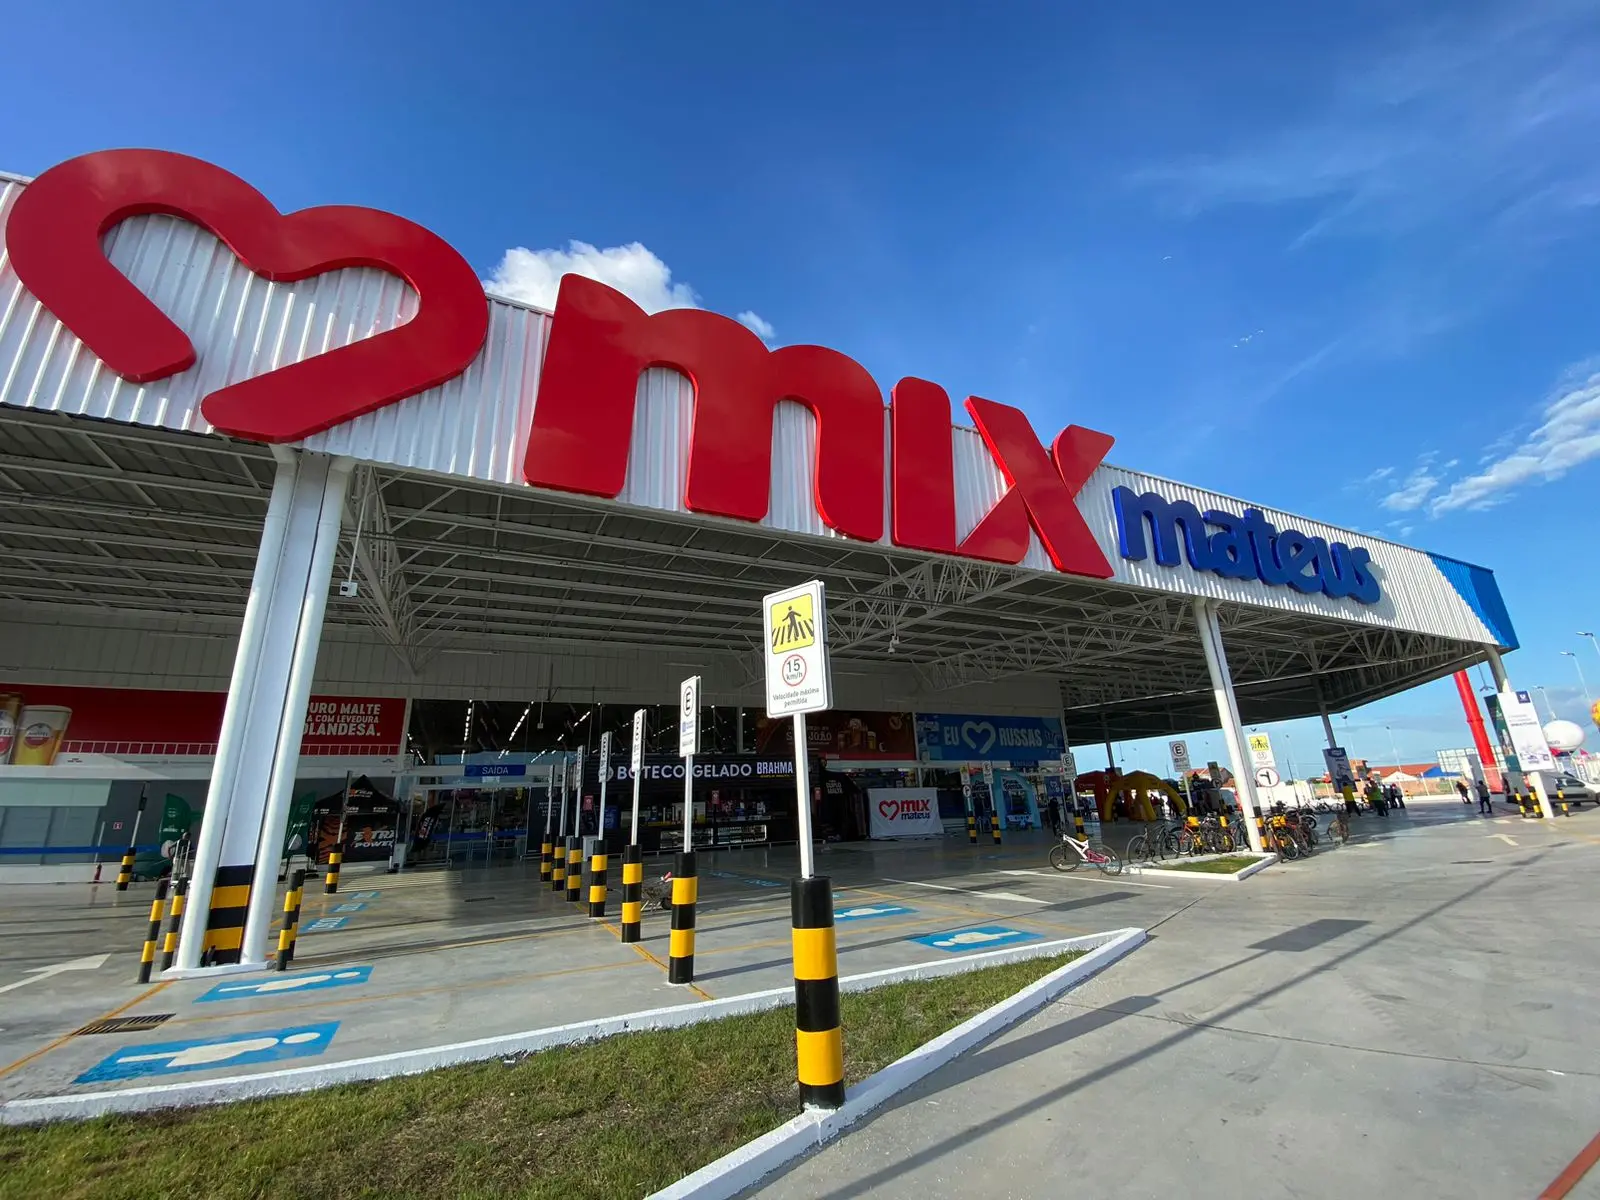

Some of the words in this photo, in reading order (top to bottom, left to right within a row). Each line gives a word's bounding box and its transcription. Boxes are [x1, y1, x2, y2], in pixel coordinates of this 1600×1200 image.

[1112, 485, 1380, 604] mateus
[786, 659, 801, 673] 15
[786, 671, 803, 680] km/h
[773, 691, 799, 700] Velocidade
[310, 702, 337, 714] URO
[340, 703, 382, 715] MALTE
[784, 698, 808, 708] permitida
[315, 715, 335, 723] COM
[337, 715, 379, 724] LEVEDURA
[303, 722, 381, 737] OLANDESA.
[944, 726, 960, 746] EU
[999, 727, 1043, 747] RUSSAS
[482, 766, 509, 775] SAÍDA
[692, 763, 752, 778] GELADO
[756, 762, 794, 774] BRAHMA
[901, 812, 930, 820] mateus
